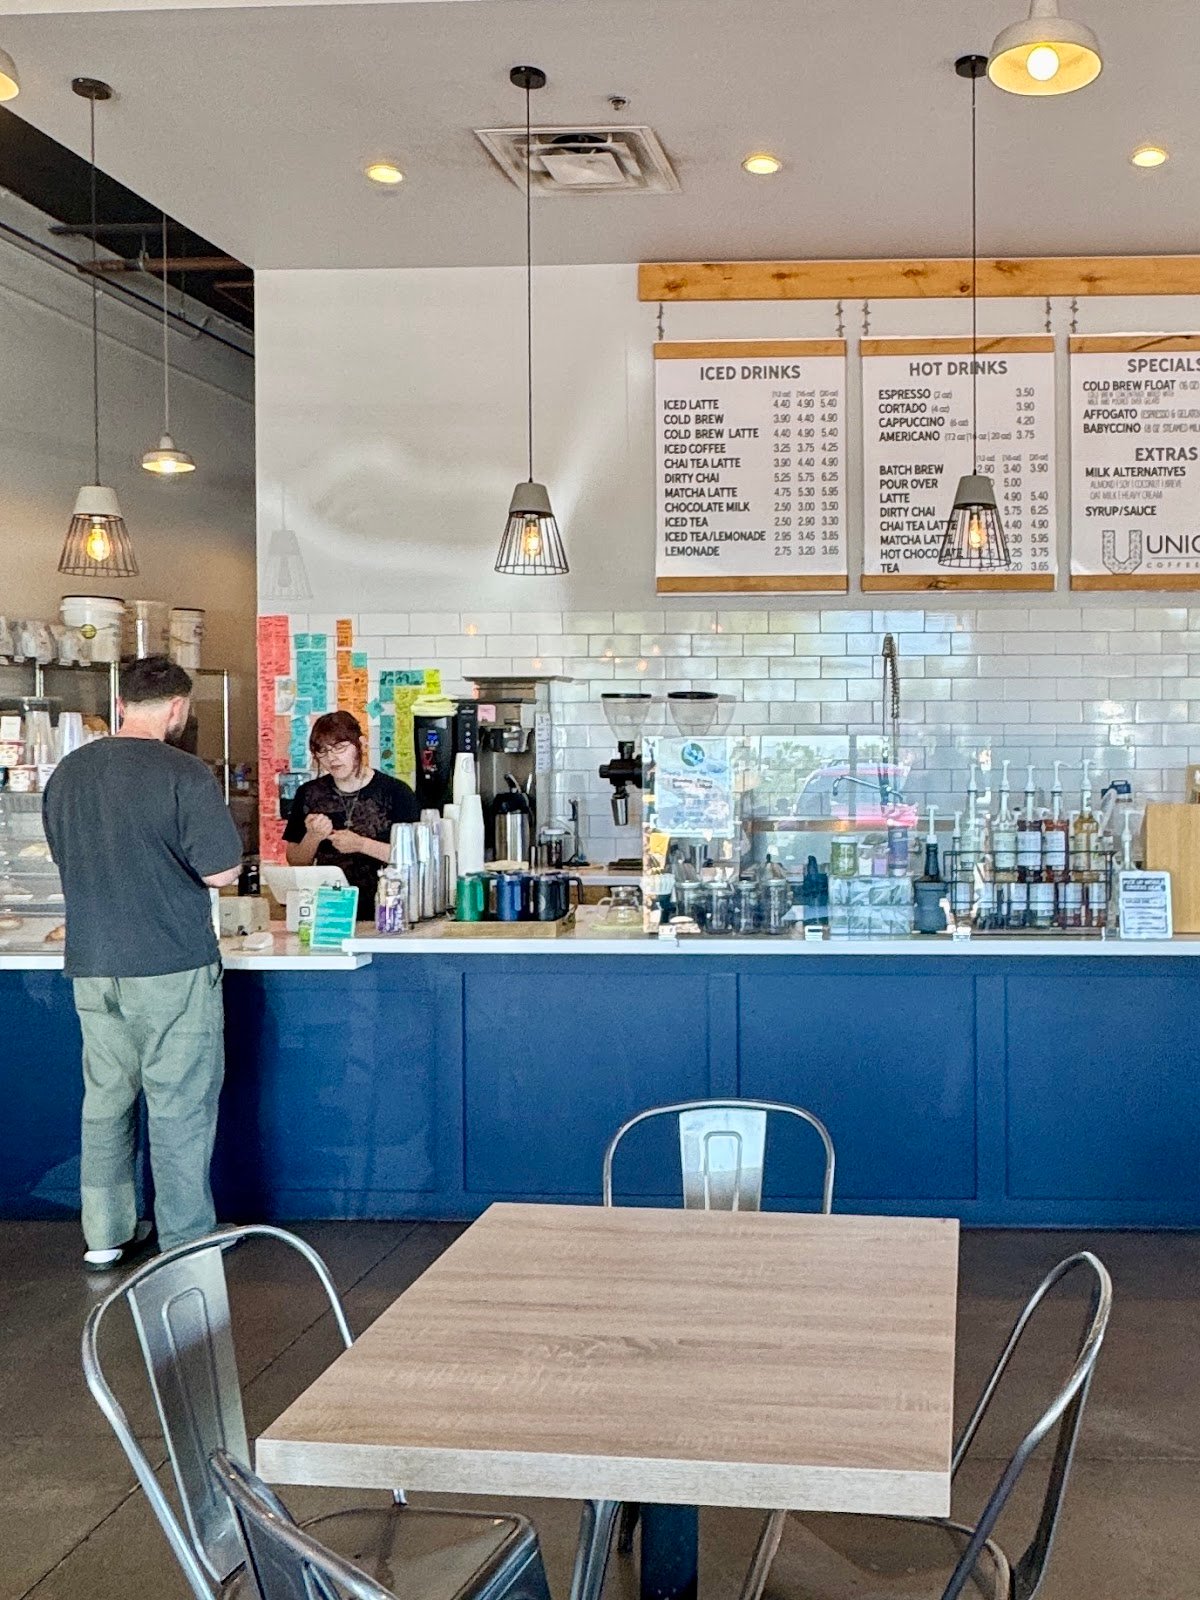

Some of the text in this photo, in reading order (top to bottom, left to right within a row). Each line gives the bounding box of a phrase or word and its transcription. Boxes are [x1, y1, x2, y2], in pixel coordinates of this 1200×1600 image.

[700, 366, 801, 380] ICED DRINKS
[909, 361, 1008, 376] HOT DRINKS
[1083, 381, 1110, 391] COLD
[1113, 381, 1142, 390] BREW
[1145, 380, 1176, 390] FLOAT
[879, 390, 931, 400] ESPRESSO
[1016, 388, 1034, 398] 3.50
[664, 398, 838, 410] ICED LATTE 4.40 4.90 5.40
[879, 404, 926, 413] CORTADO
[1016, 402, 1035, 411] 3.90
[664, 412, 838, 424] COLD BREW 3.90 4.40 4.90
[1083, 409, 1137, 419] AFFOGATO
[879, 417, 944, 427] CAPPUCCINO
[1016, 416, 1035, 425] 4.20
[664, 427, 838, 439] COLD BREW LATTE 4.40 4.90 5.40
[1084, 423, 1141, 433] BABYCCINO
[879, 431, 940, 442] AMERICANO
[1016, 430, 1035, 440] 3.75
[664, 442, 838, 454] ICED COFFEE 3.25 3.75 4.25
[1135, 447, 1198, 461] EXTRAS
[664, 457, 838, 468] CHAI TEA LATTE 3.90 4.40 4.90
[880, 464, 1048, 475] BATCH BREW 2.90 3.40 3.90
[1085, 467, 1186, 477] MILK ALTERNATIVES
[665, 472, 838, 483] DIRTY CHAI 5.25 5.75 6.25
[880, 479, 908, 489] POUR
[911, 479, 938, 488] OVER
[1004, 478, 1022, 487] 5.00
[665, 486, 838, 498] MATCHA LATTE 4.75 5.30 5.95
[880, 492, 1048, 503] LATTE 4.90 5.40
[665, 501, 838, 512] CHOCOLATE MILK 2.50 3.00 3.50
[880, 506, 1048, 517] DIRTY CHAI 5.75 6.25
[1085, 506, 1156, 516] SYRUP/SAUCE
[665, 516, 838, 527] ICED TEA 2.50 2.90 3.30
[880, 521, 904, 531] CHAI
[907, 521, 925, 531] TEA
[1004, 521, 1022, 529] 4.40
[1031, 520, 1049, 528] 4.90
[665, 531, 838, 541] ICED TEA/LEMONADE 2.95 3.45 3.85
[880, 535, 921, 545] MATCHA
[1031, 534, 1049, 542] 5.95
[666, 545, 838, 556] LEMONADE 2.75 3.20 3.65
[880, 549, 900, 559] HOT
[1032, 548, 1049, 556] 3.75
[882, 563, 899, 573] TEA
[1031, 562, 1049, 570] 3.65
